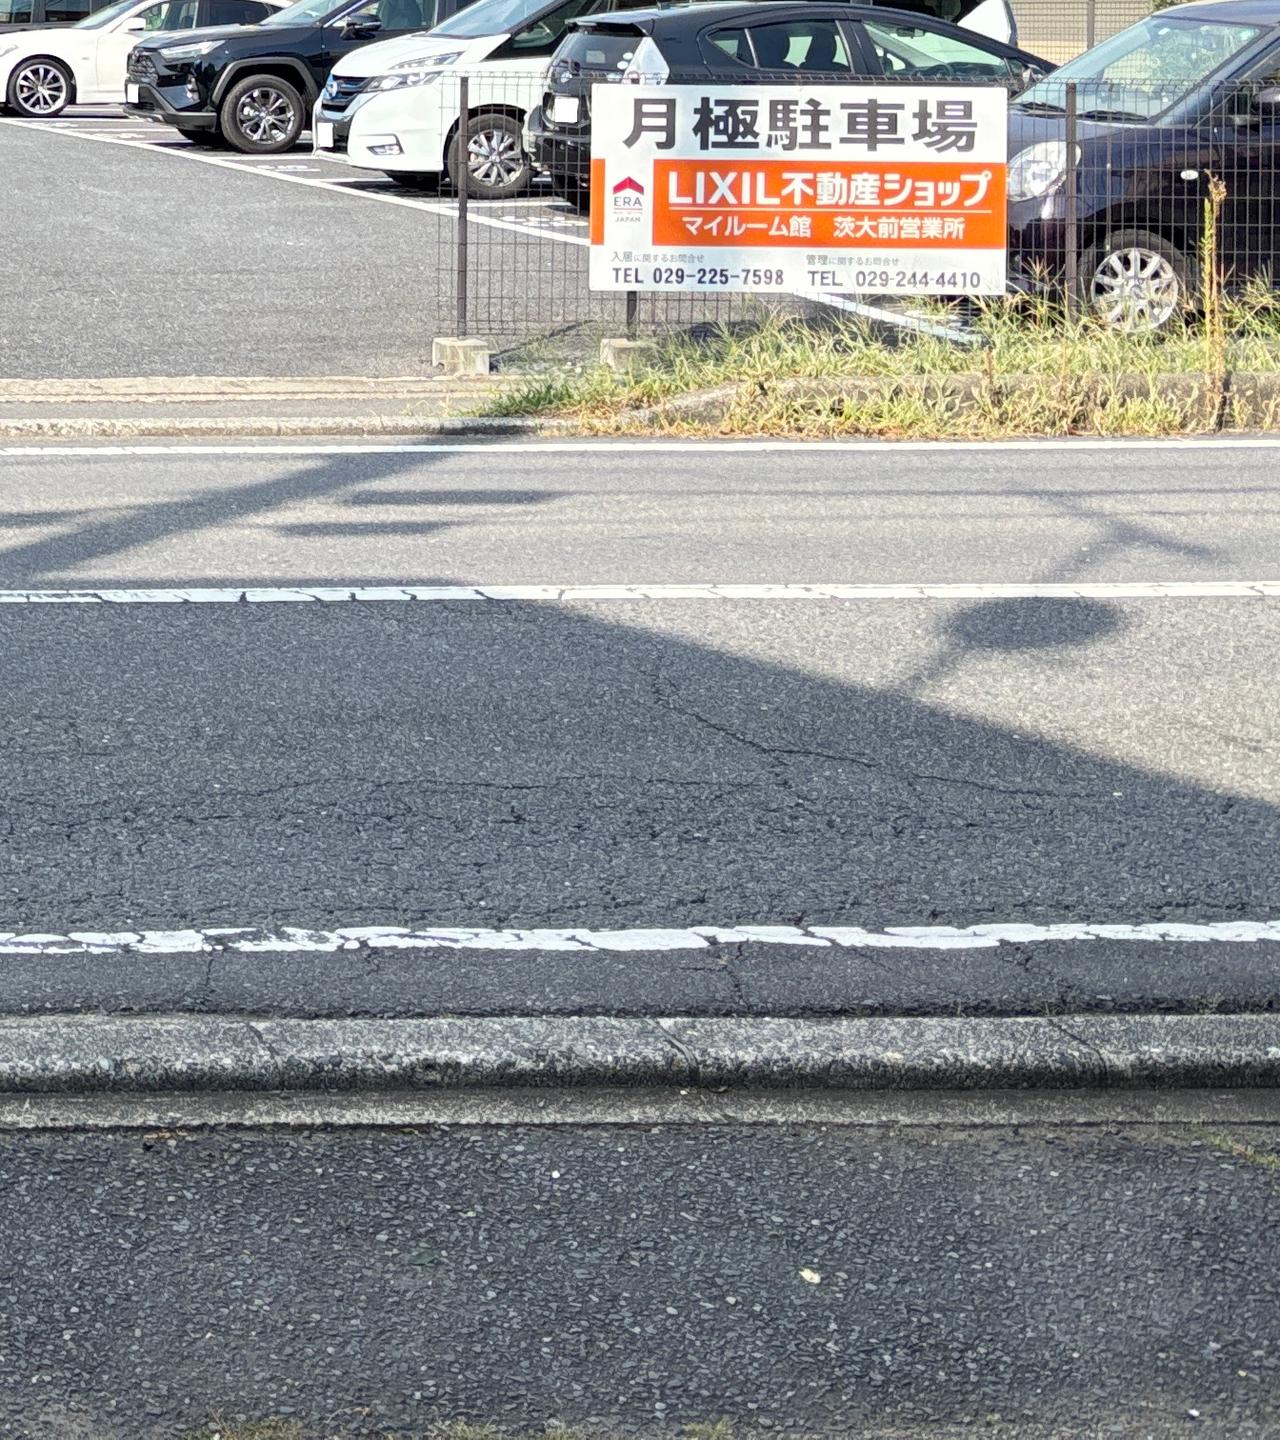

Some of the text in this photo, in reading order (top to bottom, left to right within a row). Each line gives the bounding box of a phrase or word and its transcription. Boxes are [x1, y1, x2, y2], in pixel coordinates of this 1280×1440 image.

[622, 96, 979, 153] 月極駐車場
[667, 170, 993, 208] LIXIL不動産ショップ
[613, 196, 643, 207] ERA
[681, 215, 965, 240] マイルーム館 茨大前営業所
[612, 267, 785, 285] TEL 029-225-7598
[807, 270, 982, 289] TEL 029-244-4410
